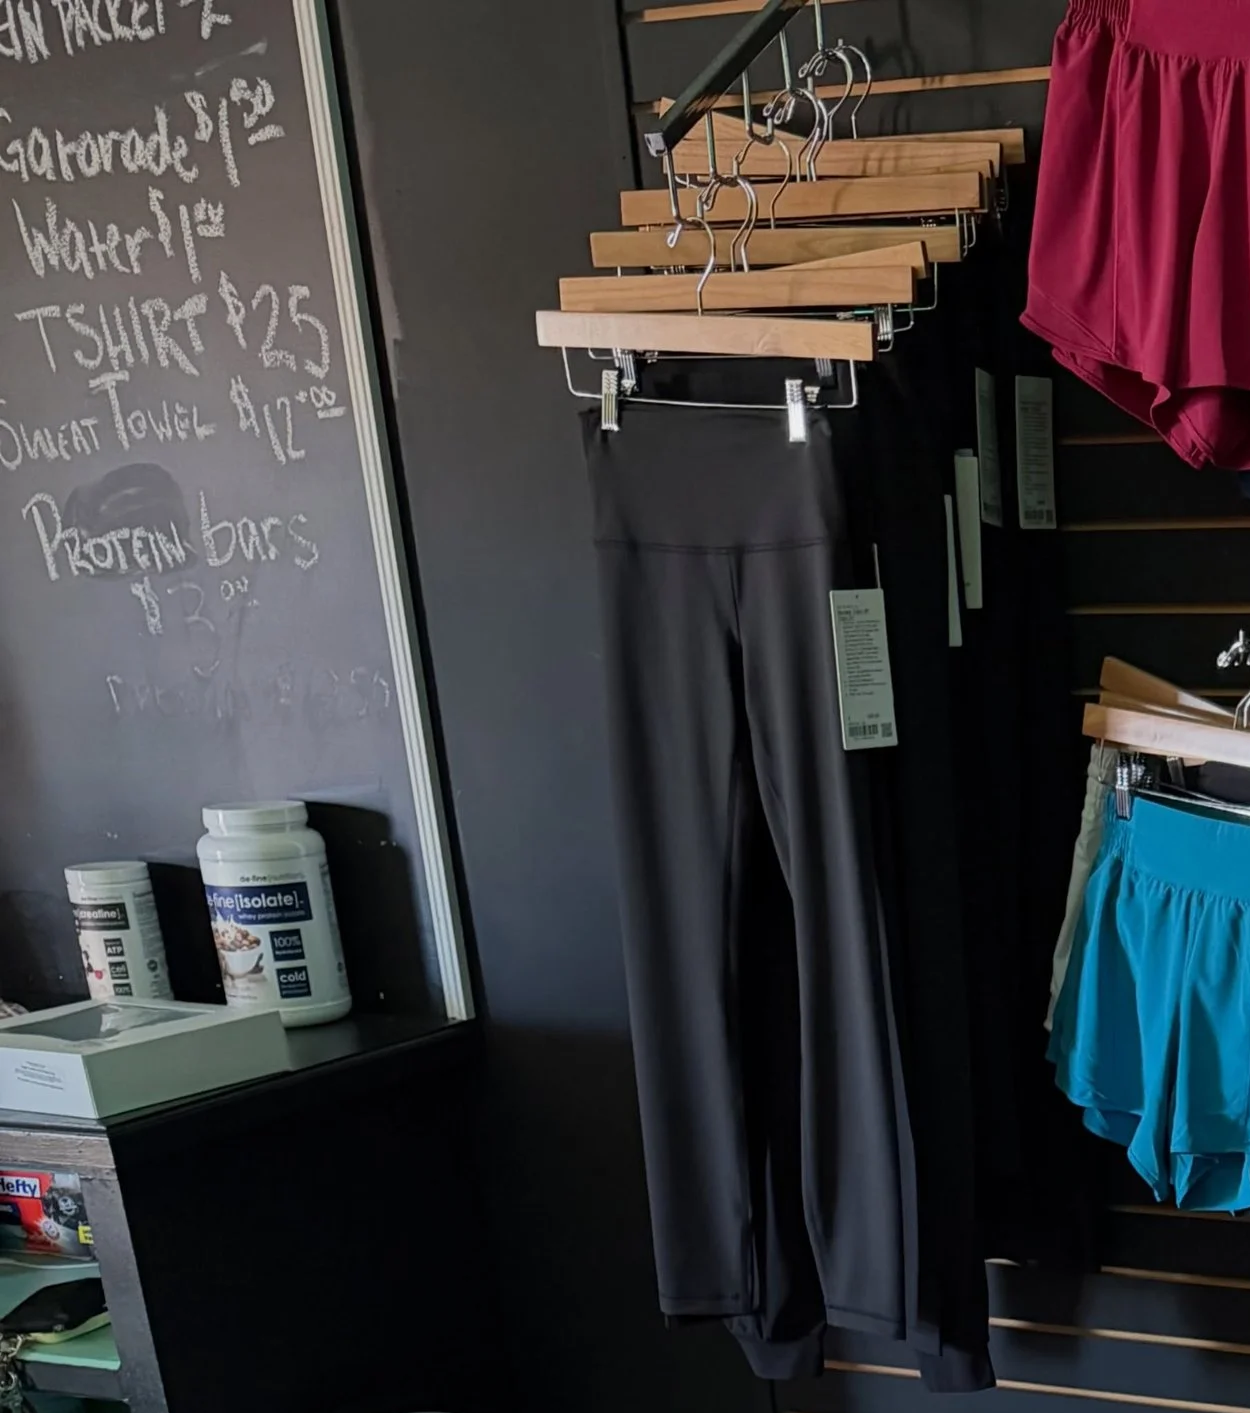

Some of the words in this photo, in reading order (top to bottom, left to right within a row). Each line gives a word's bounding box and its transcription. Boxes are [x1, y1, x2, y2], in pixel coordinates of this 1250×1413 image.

[12, 198, 152, 279] Water
[15, 294, 208, 376] TSHIRT
[219, 271, 330, 379] $25
[89, 370, 215, 450] TOWEL
[200, 491, 320, 569] bars
[106, 946, 123, 955] ATP
[280, 971, 306, 983] cold
